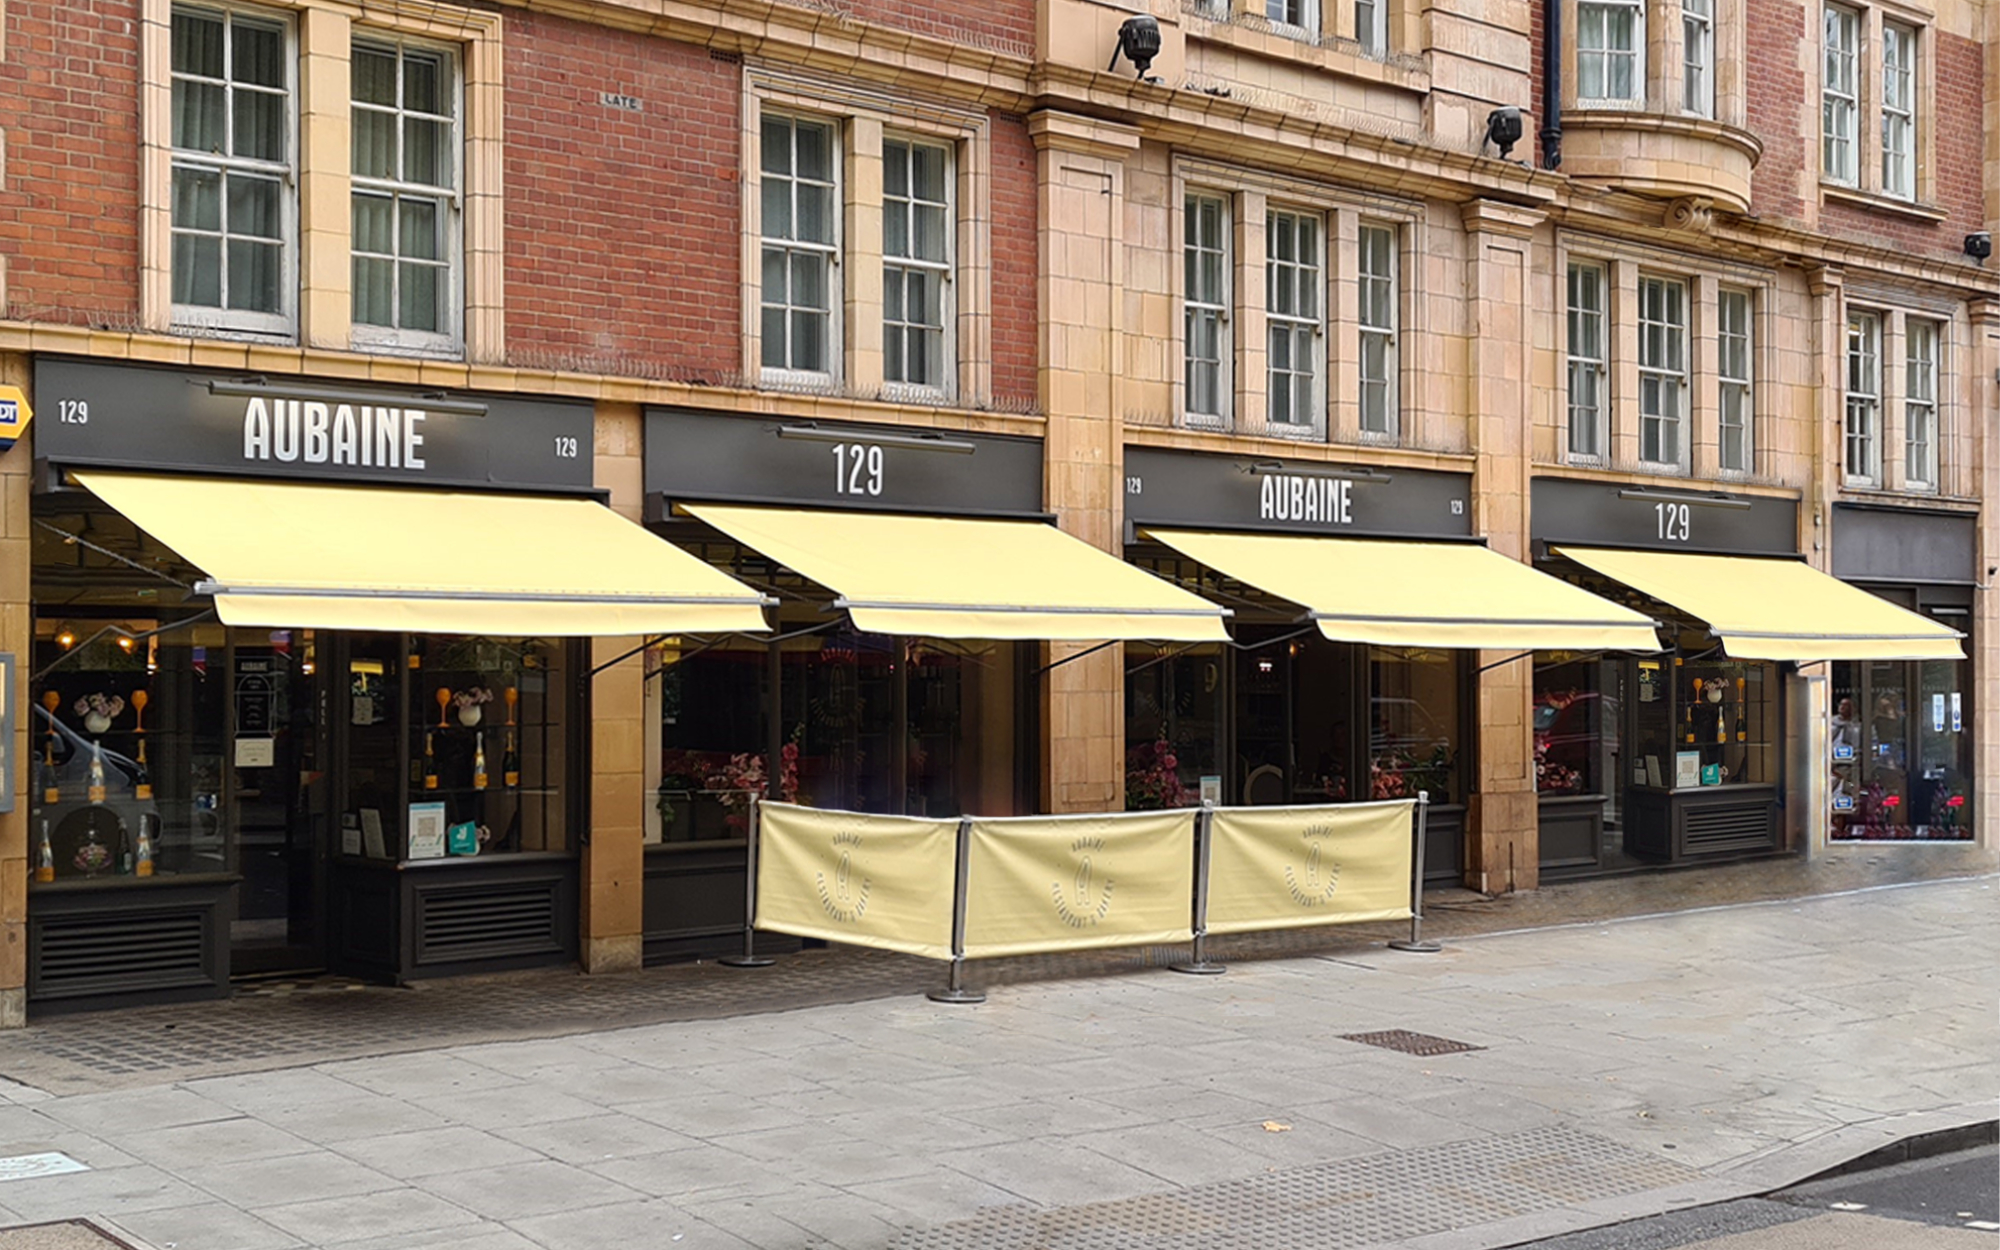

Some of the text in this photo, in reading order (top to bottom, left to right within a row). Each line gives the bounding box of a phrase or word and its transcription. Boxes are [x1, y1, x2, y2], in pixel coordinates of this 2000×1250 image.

[605, 94, 637, 110] LATE
[58, 399, 89, 425] 129
[243, 397, 426, 470] AUBAINE
[554, 436, 578, 458] 129
[832, 444, 884, 496] 129
[1126, 477, 1142, 495] 129
[1261, 474, 1353, 524] AUBAINE
[1655, 502, 1690, 541] 129
